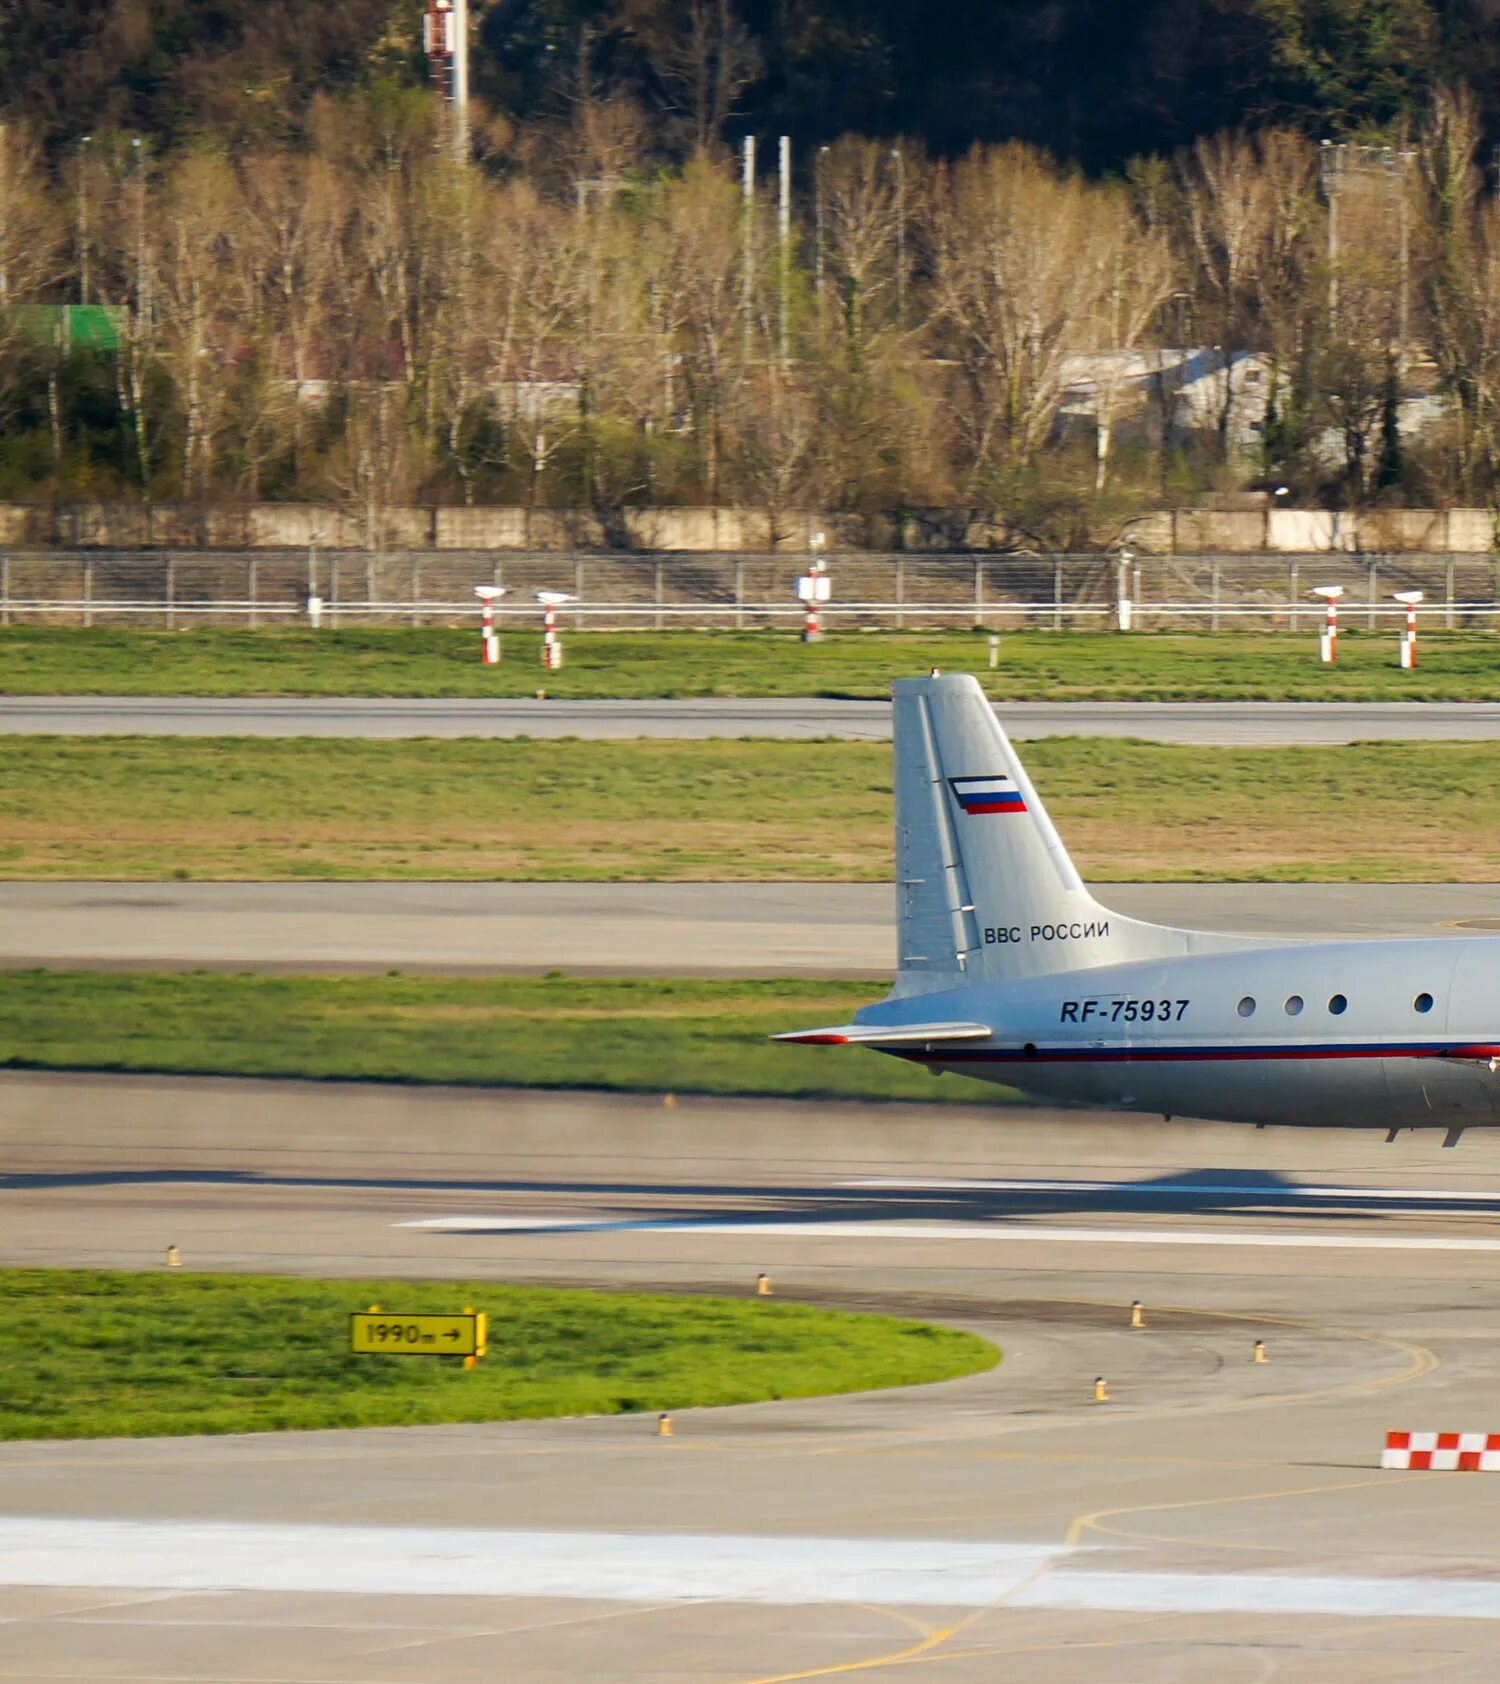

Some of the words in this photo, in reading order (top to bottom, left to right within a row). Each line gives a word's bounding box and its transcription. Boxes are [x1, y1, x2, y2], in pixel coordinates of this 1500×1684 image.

[984, 927, 1021, 944] ВВС
[1030, 921, 1109, 942] РОССИИ
[1060, 1000, 1189, 1024] RF-75937
